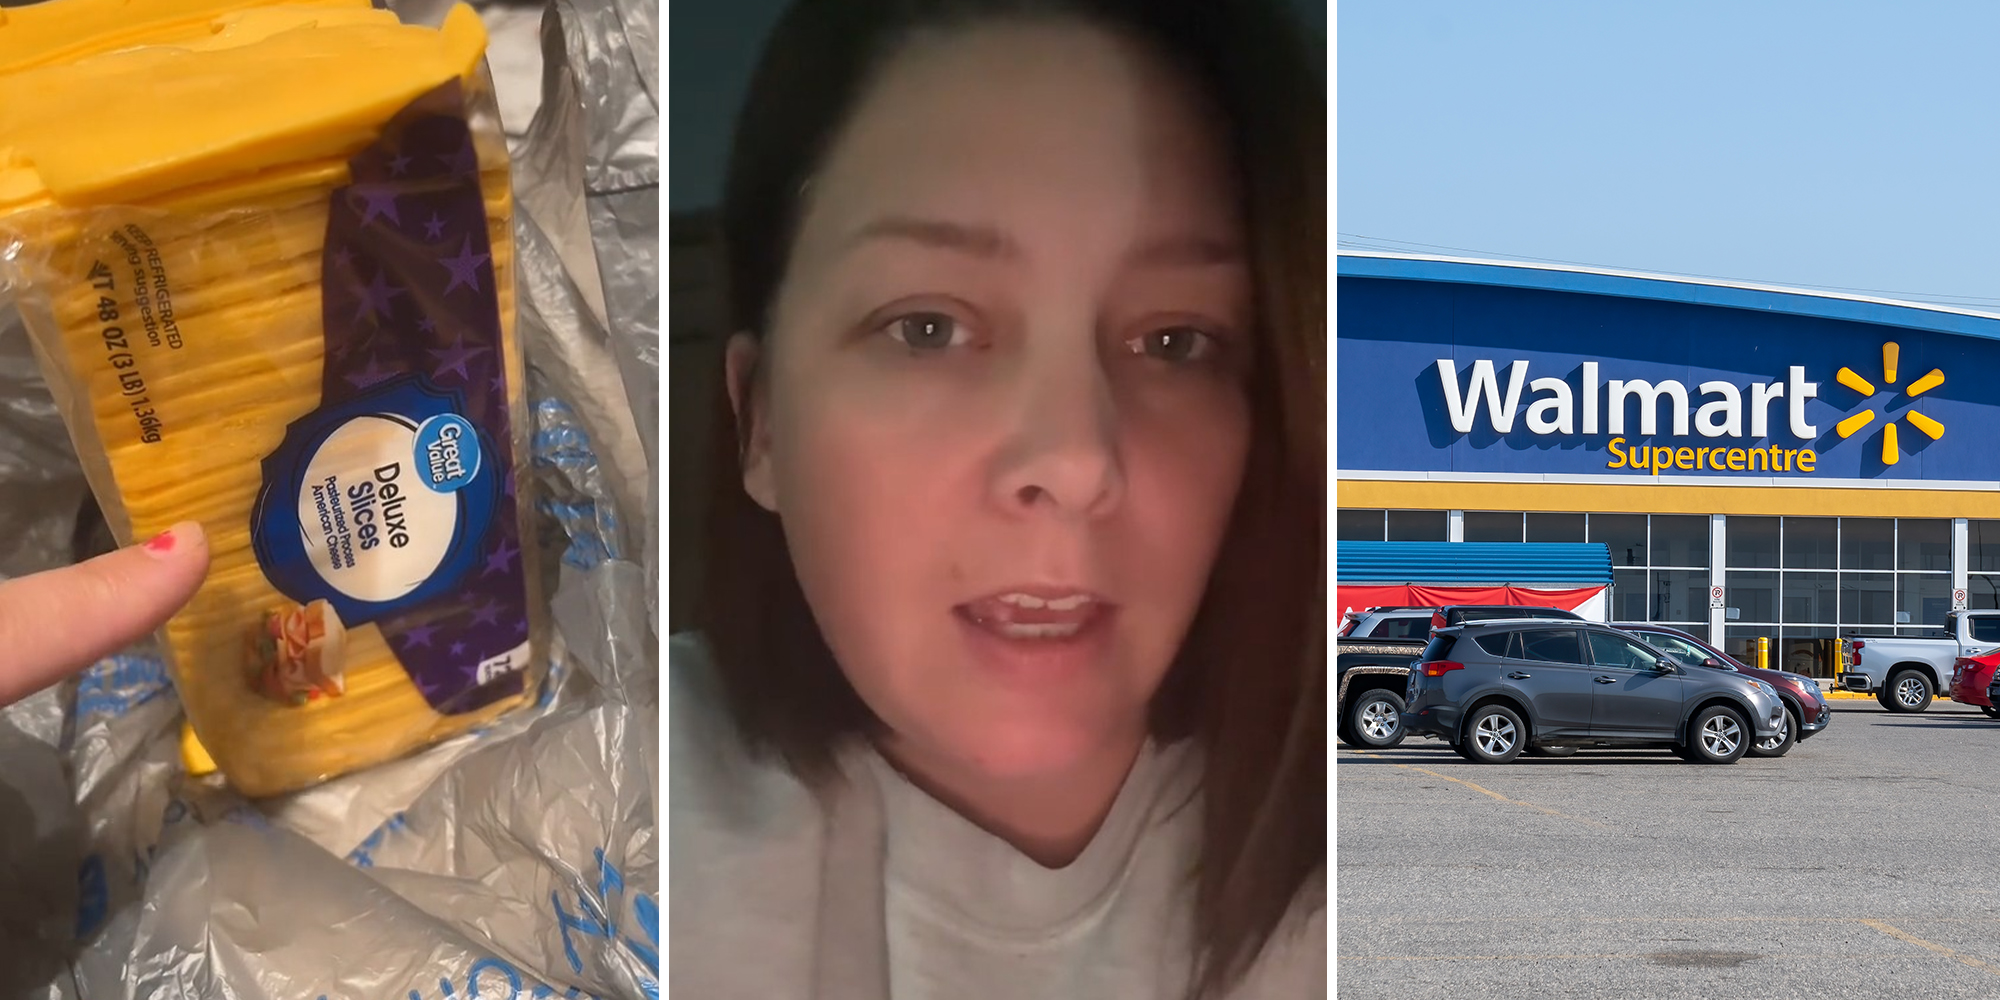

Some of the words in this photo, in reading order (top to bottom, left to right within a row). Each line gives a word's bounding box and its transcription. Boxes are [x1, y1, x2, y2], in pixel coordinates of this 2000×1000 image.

[97, 296, 119, 322] 48
[123, 223, 153, 247] KEEP
[146, 247, 183, 350] REFRIGERATED
[134, 268, 161, 347] suggestion
[102, 327, 129, 351] OZ
[108, 352, 135, 370] (3
[118, 371, 147, 396] LB)
[1436, 359, 1818, 439] Walmart
[130, 397, 163, 444] 1.36kg
[425, 440, 446, 484] Value
[439, 422, 467, 481] Great
[1607, 437, 1817, 476] Supercentre
[311, 485, 333, 536] American
[326, 535, 342, 570] Cheese
[324, 475, 350, 535] Pasteurized
[340, 532, 355, 568] Process
[347, 480, 381, 551] Slices
[374, 462, 409, 549] Deluxe
